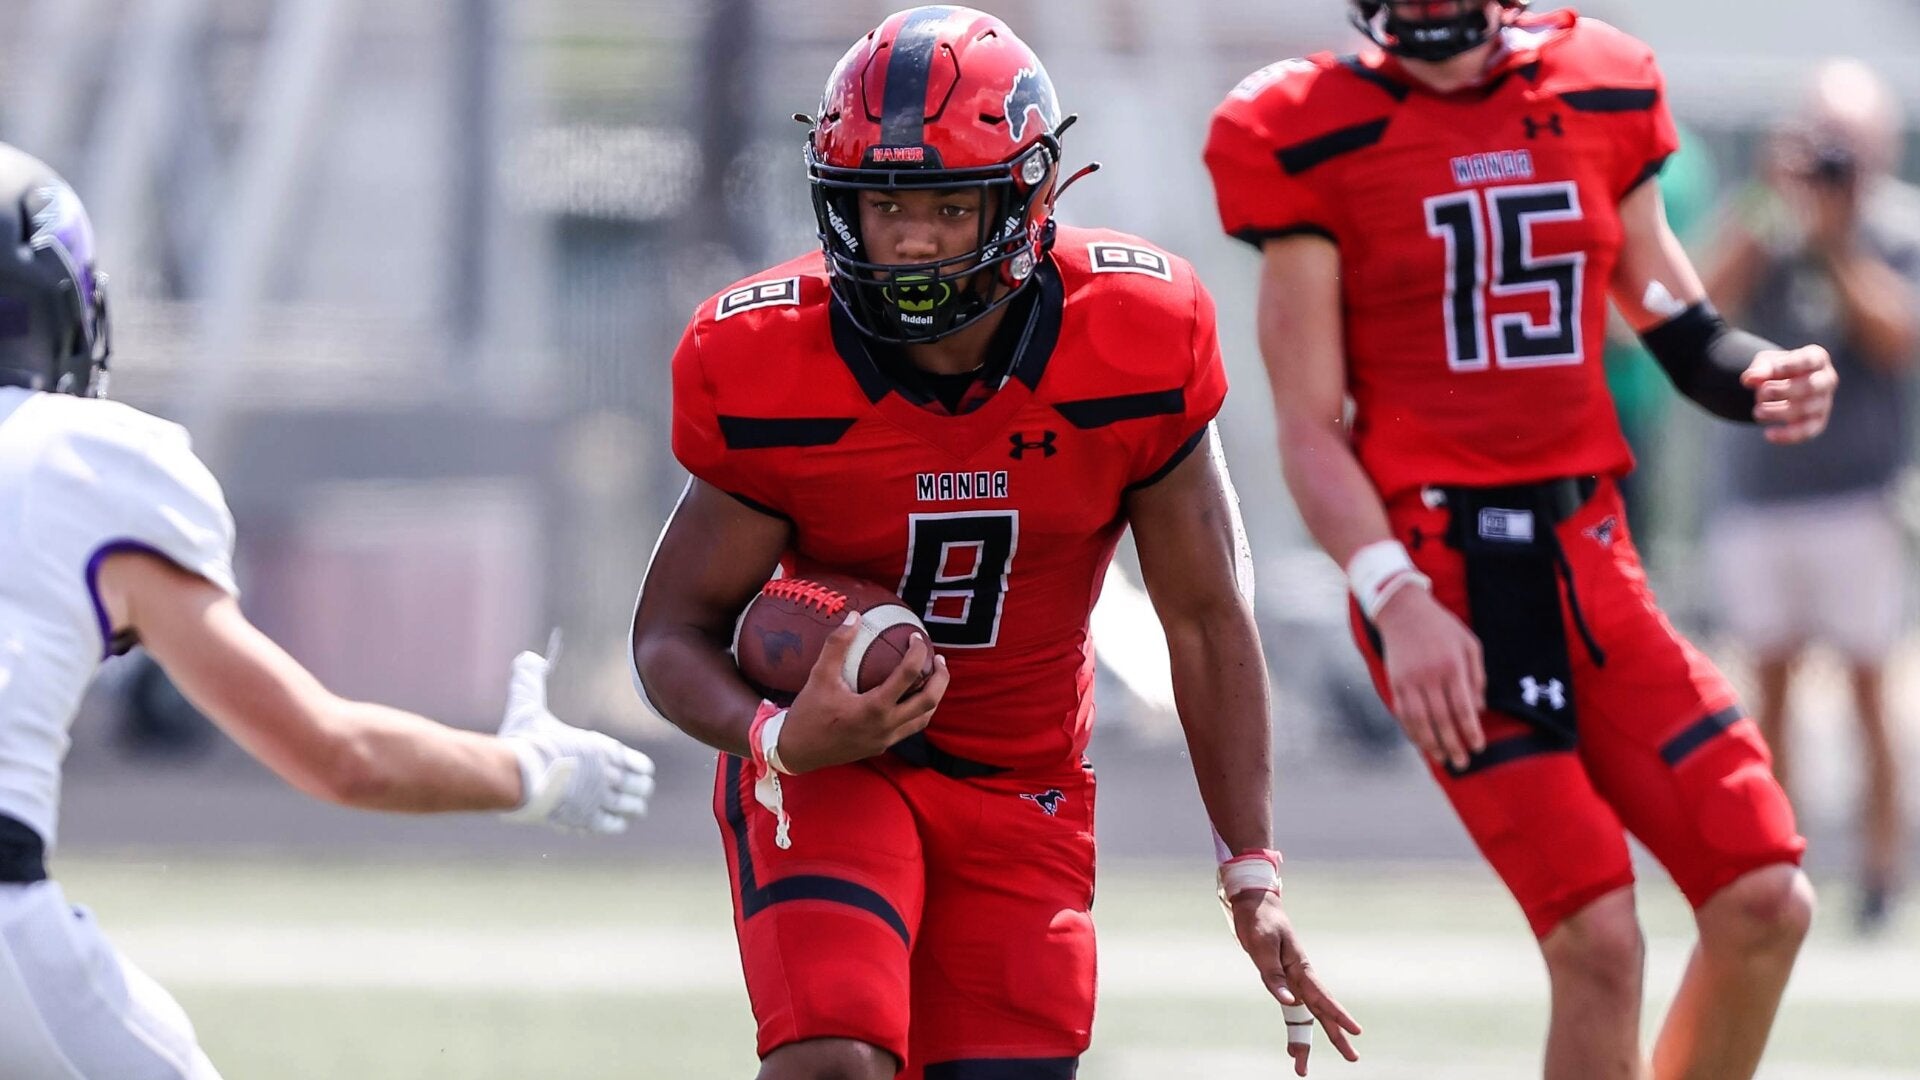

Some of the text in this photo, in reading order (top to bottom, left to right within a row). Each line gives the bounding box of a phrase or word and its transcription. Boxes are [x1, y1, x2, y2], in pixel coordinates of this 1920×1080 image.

[1086, 241, 1172, 282] 8
[1423, 180, 1586, 373] 15
[715, 276, 800, 321] 8
[900, 313, 933, 324] Riddell
[916, 471, 1008, 501] MANOR
[897, 509, 1019, 648] 8
